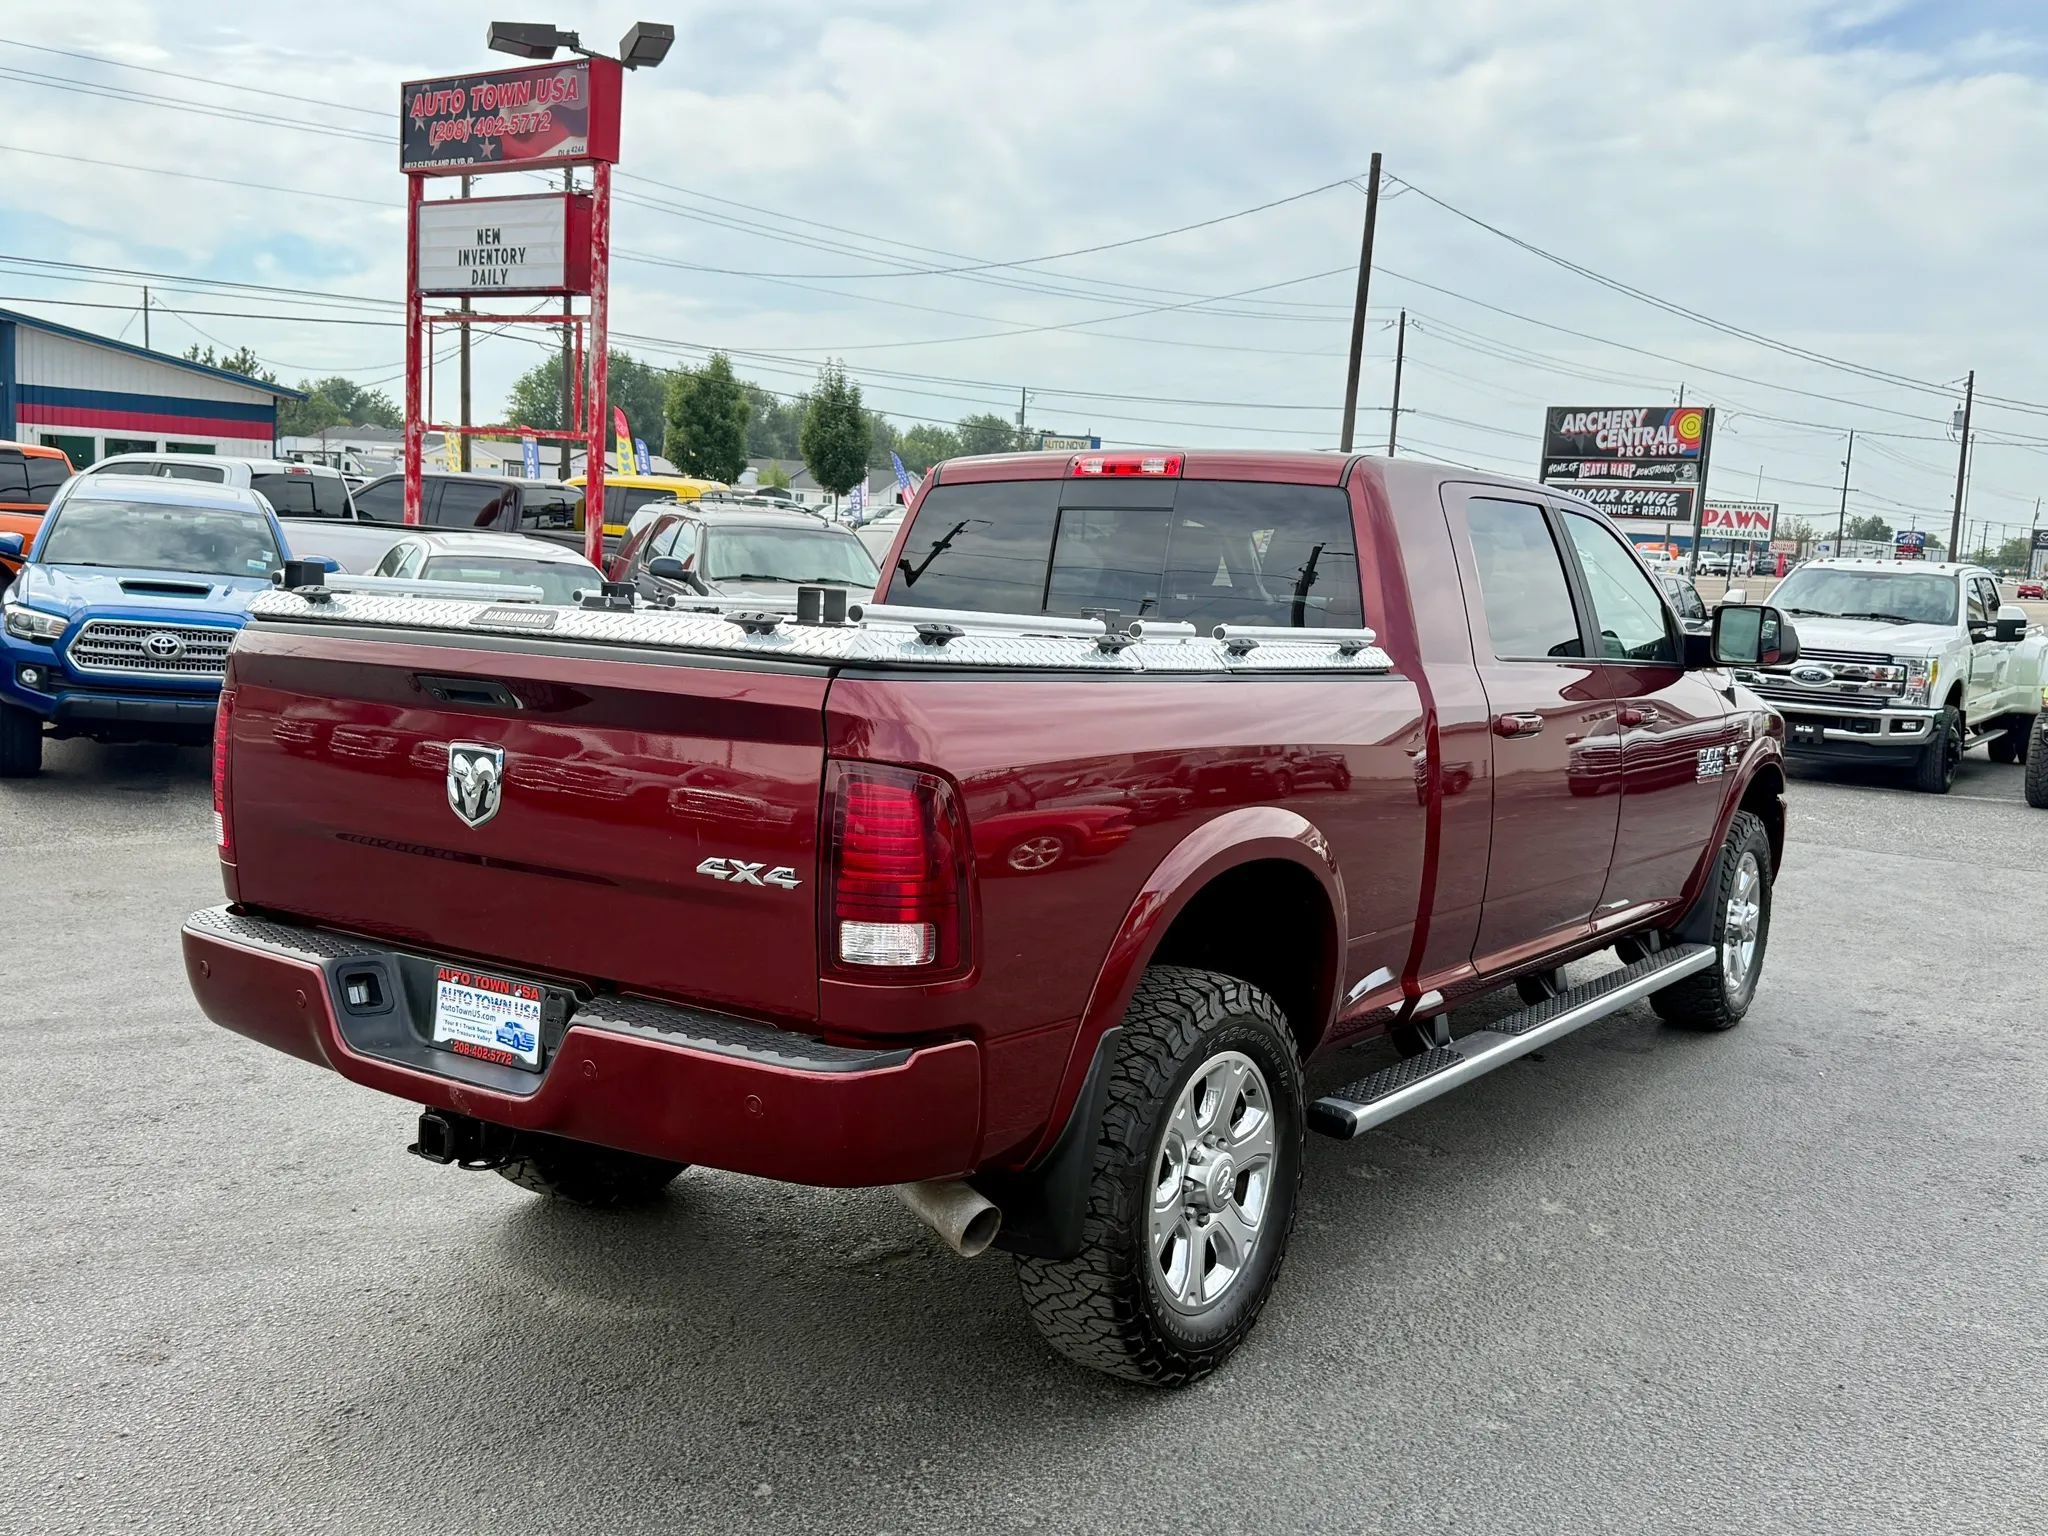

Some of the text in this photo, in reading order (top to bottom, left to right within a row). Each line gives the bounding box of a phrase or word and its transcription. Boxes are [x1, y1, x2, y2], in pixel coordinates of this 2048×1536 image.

[410, 75, 578, 117] AUTO TOWN USA
[429, 111, 552, 146] (208) 402-5772
[418, 159, 449, 168] CLEVELAND
[477, 228, 501, 246] NEW
[458, 247, 526, 266] INVENTORY
[472, 268, 508, 286] DAILY
[1560, 408, 1648, 434] ARCHERY
[1045, 440, 1064, 449] AUTO
[1596, 425, 1679, 450] CENTRAL
[1617, 443, 1687, 457] PRO SHOP
[1548, 463, 1568, 474] HOME
[1568, 461, 1580, 472] OF
[1579, 461, 1608, 478] DEATH
[1610, 461, 1636, 478] HARP
[1622, 490, 1680, 506] RANGE
[1642, 506, 1678, 516] REPAIR
[1702, 509, 1771, 530] PAWN
[483, 610, 551, 624] DIAMONDBACK
[438, 968, 471, 985] AUTO
[473, 975, 510, 993] TOWN
[440, 987, 473, 1006] AUTO
[474, 993, 512, 1015] TOWN
[440, 1003, 496, 1022] AutoTownUS.com
